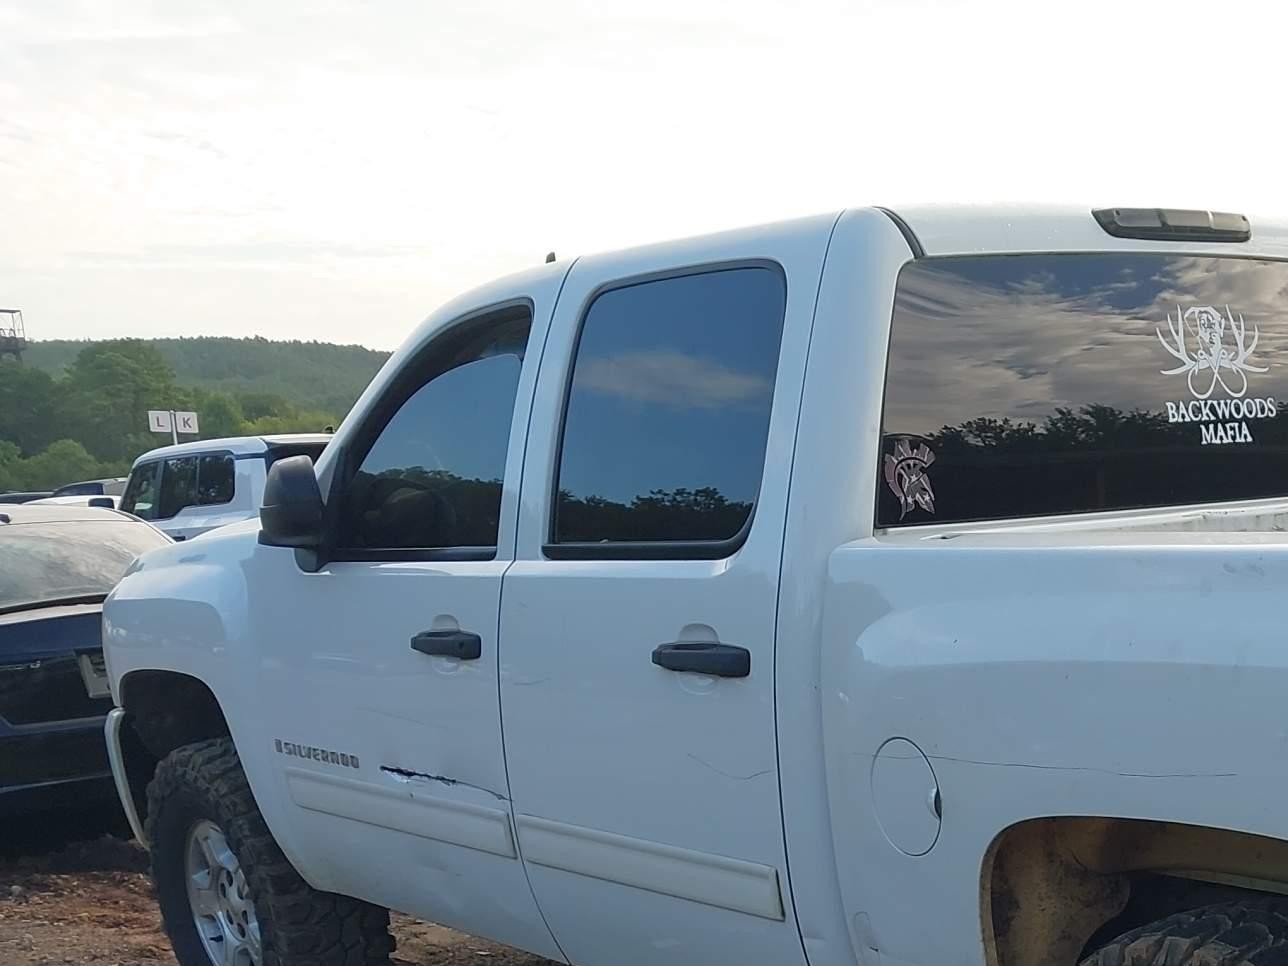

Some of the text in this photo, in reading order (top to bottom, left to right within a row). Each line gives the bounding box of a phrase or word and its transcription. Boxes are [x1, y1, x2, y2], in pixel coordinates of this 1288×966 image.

[156, 416, 165, 427] L
[1166, 398, 1276, 423] BACKWOODS
[182, 417, 192, 428] K
[1200, 422, 1253, 445] MAFIA
[284, 742, 359, 768] SILVERADO
